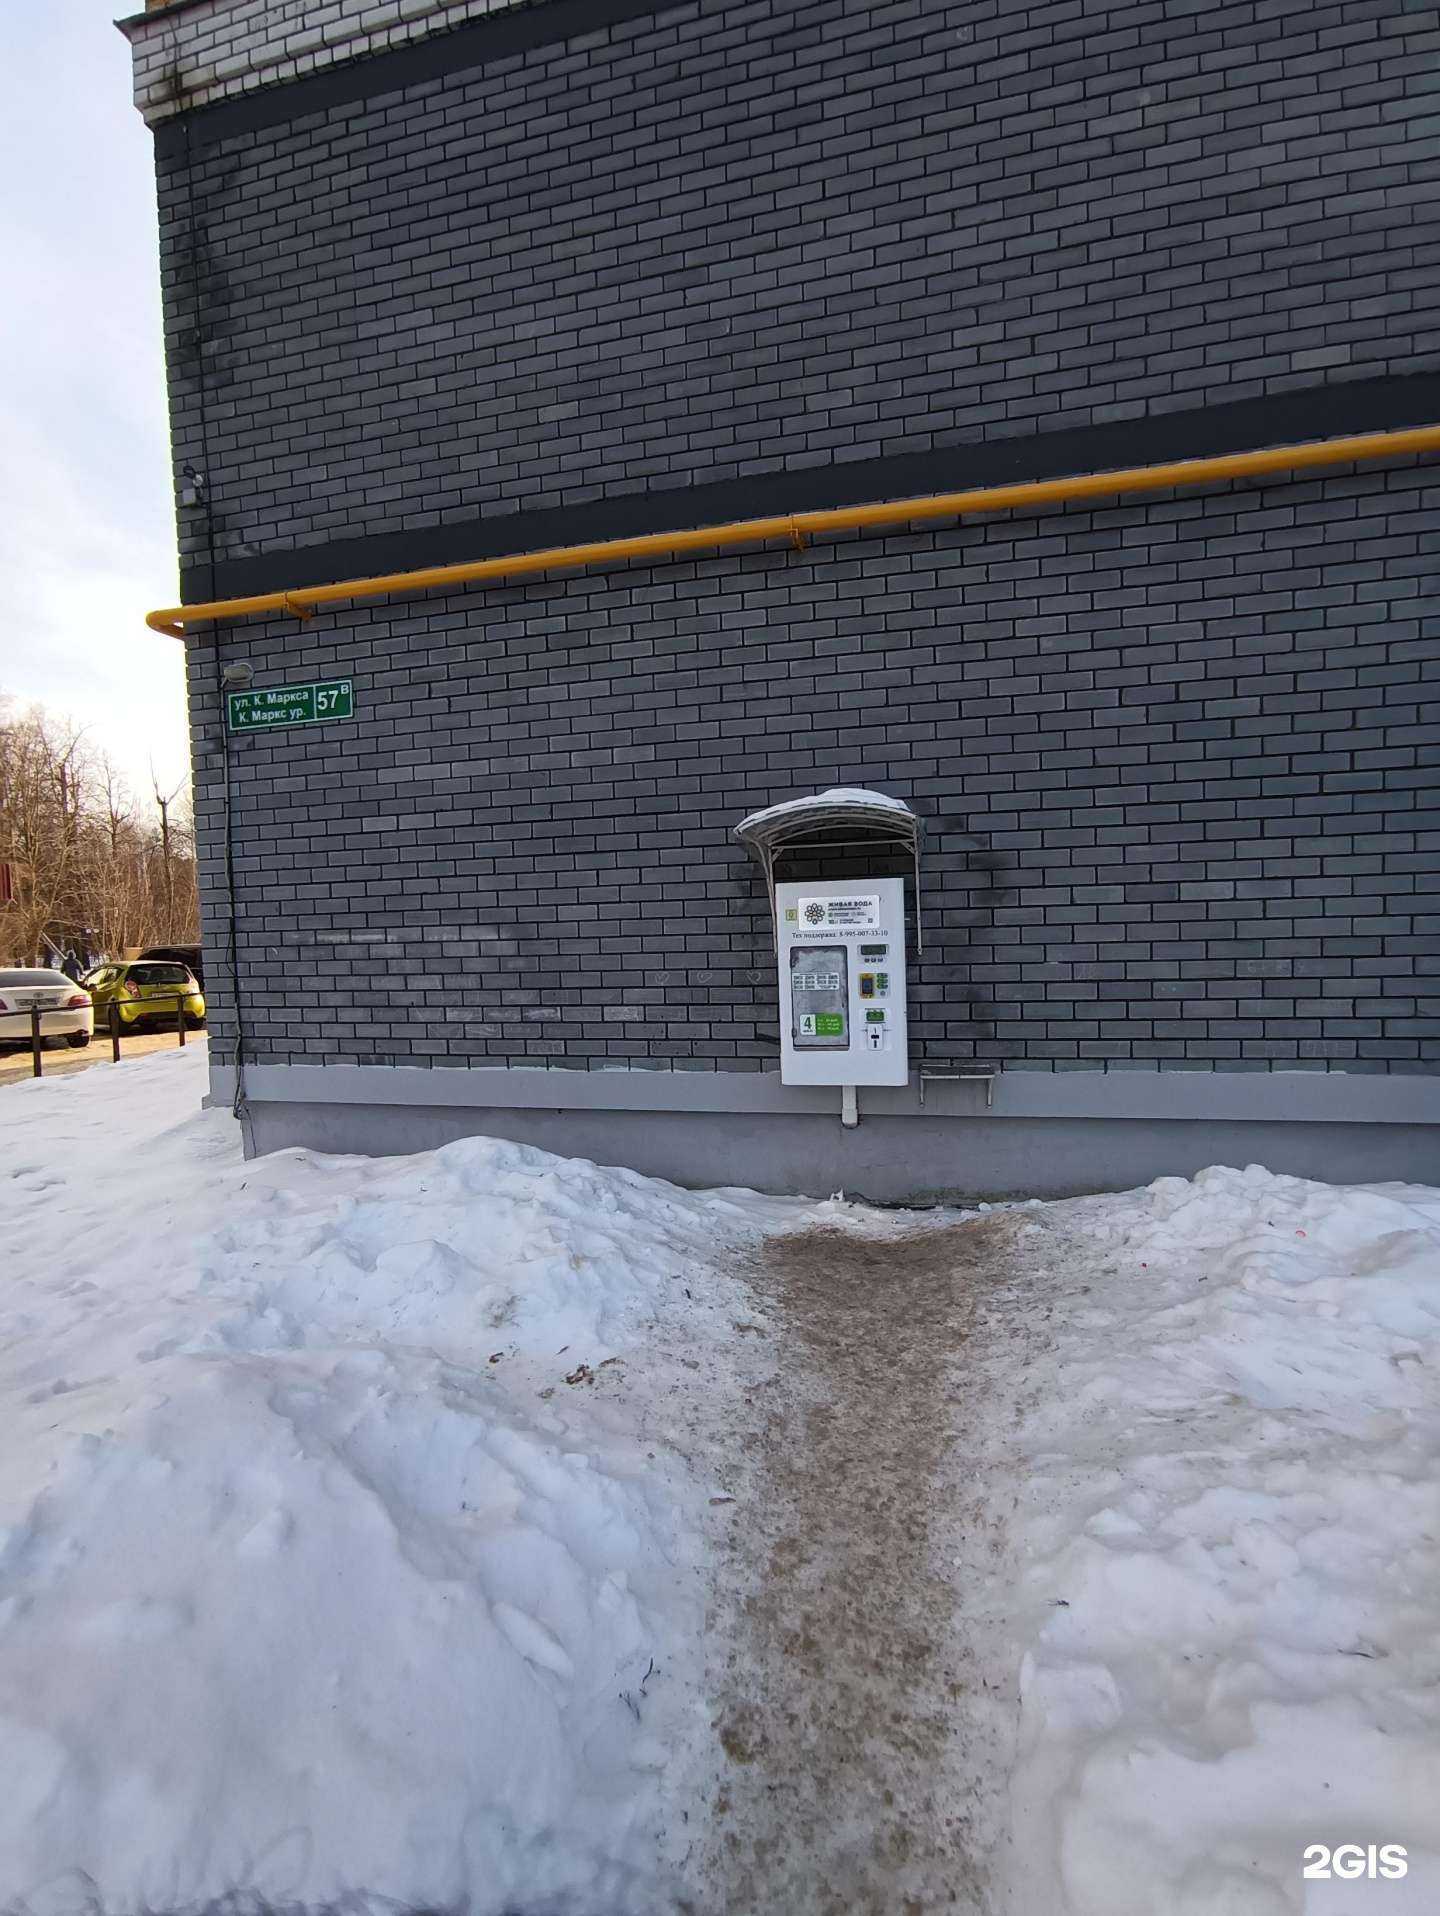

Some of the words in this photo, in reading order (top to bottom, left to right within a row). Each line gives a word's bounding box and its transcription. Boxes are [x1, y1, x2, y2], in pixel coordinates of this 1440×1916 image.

[235, 698, 251, 711] ул.
[254, 695, 265, 706] К.
[267, 691, 309, 705] Маркса
[252, 709, 287, 724] Маркс
[289, 707, 306, 720] ур.
[804, 1016, 812, 1029] 4
